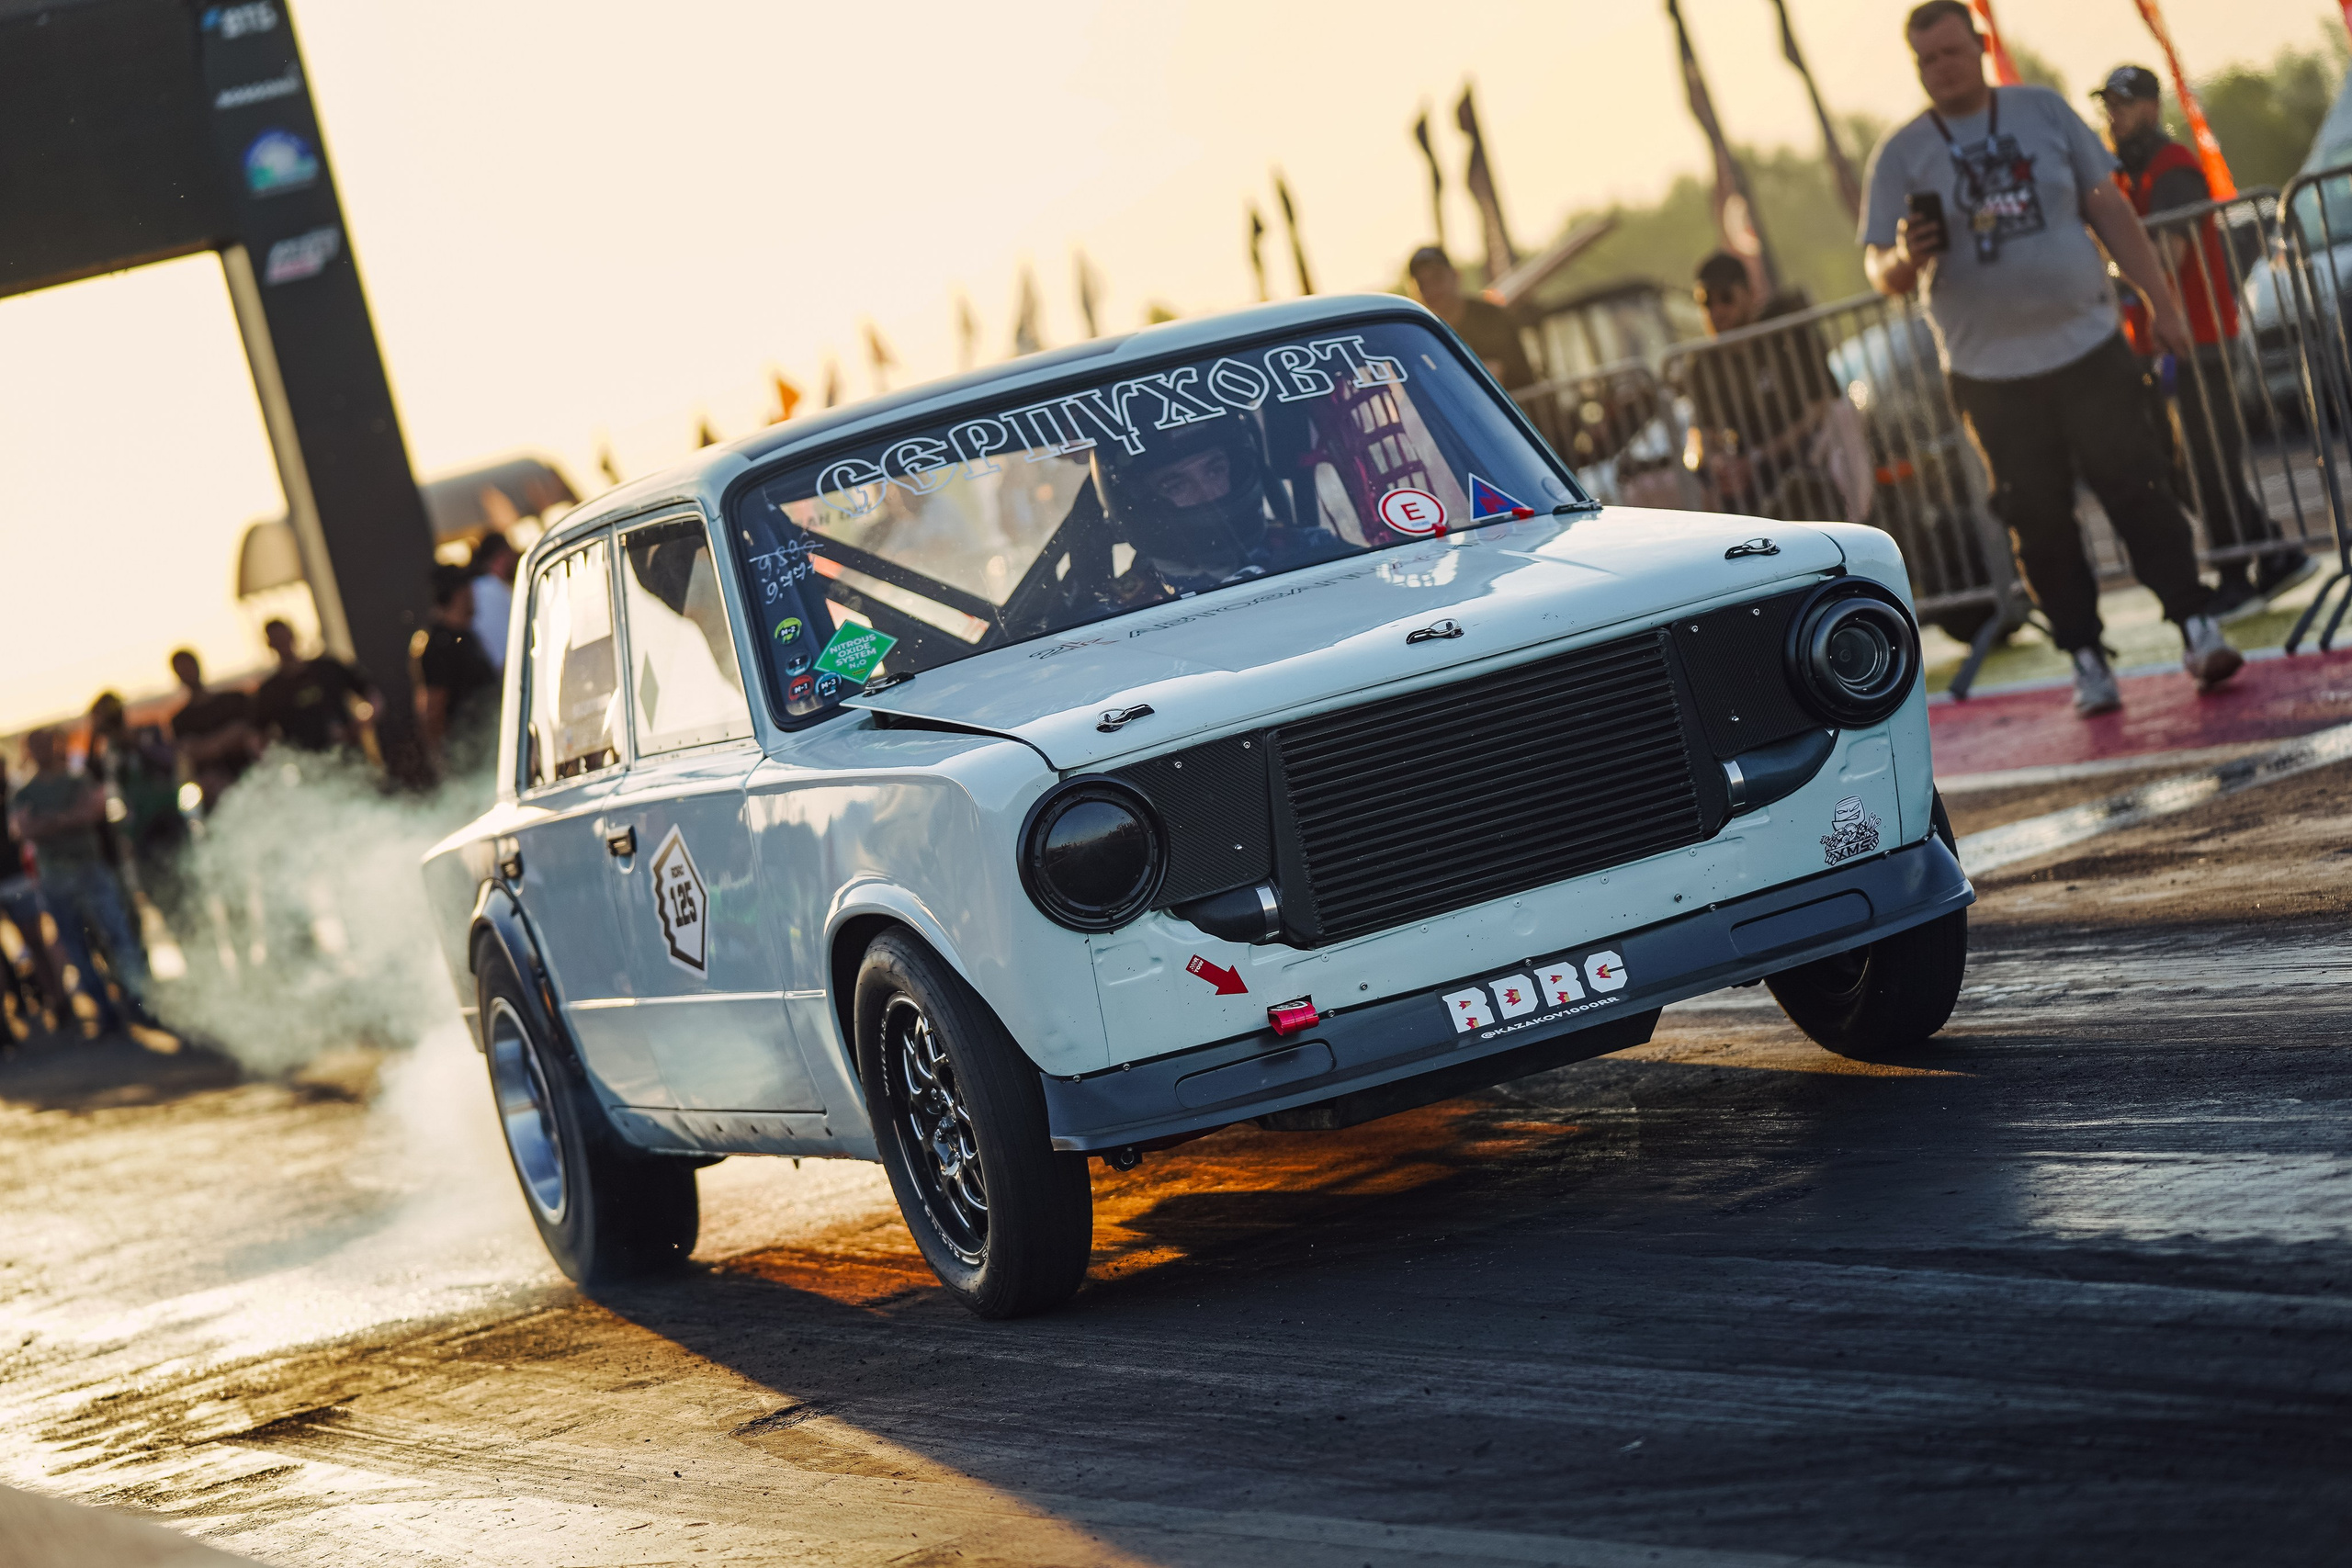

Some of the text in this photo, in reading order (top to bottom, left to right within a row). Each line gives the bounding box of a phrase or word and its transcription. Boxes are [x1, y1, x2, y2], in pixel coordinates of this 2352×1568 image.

[830, 633, 877, 655] NITROUS
[837, 641, 872, 658] OXIDE
[835, 647, 877, 667] SYSTEM
[670, 879, 698, 928] 125
[1193, 959, 1204, 974] TOW
[1442, 950, 1628, 1033] RDRC
[1480, 996, 1621, 1040] @KAZAKOV1000RR
